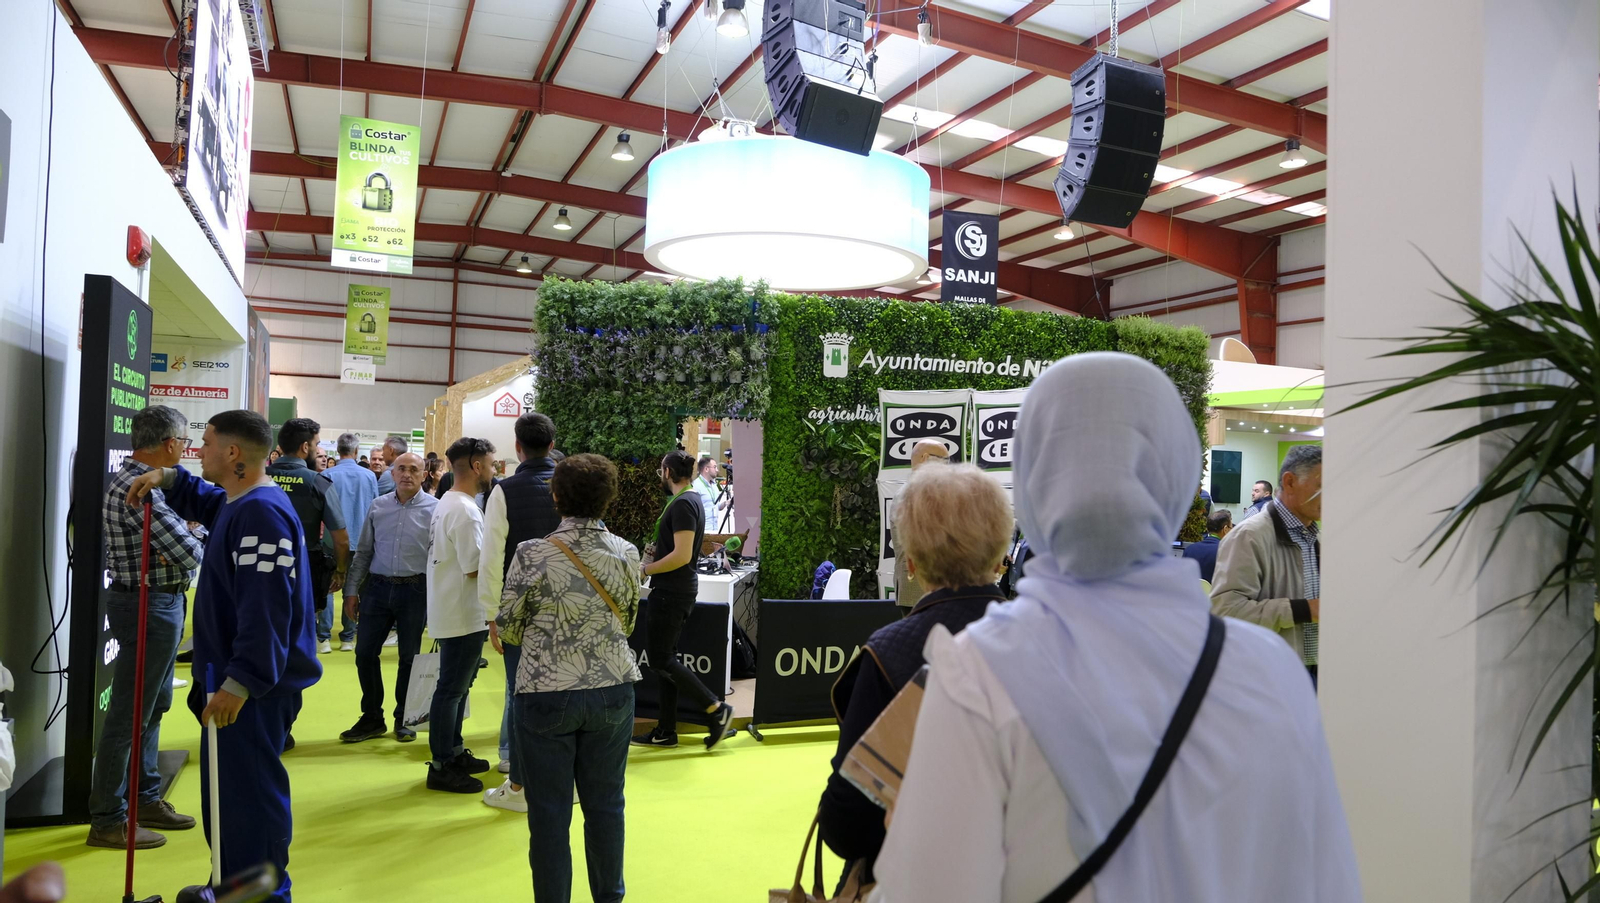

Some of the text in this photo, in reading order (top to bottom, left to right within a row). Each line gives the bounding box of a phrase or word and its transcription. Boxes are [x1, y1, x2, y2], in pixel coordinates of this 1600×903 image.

[365, 129, 407, 141] Costar
[350, 142, 396, 154] BLINDA
[349, 152, 410, 165] CULTIVOS
[944, 267, 995, 285] SANJI
[954, 295, 977, 303] MALLAS
[858, 348, 995, 375] Ayuntamiento
[996, 355, 1020, 376] de
[113, 362, 121, 382] EL
[166, 387, 181, 396] de
[182, 388, 227, 398] Almería
[807, 403, 882, 425] agricultur
[113, 415, 124, 434] DEL
[896, 419, 951, 431] ONDA
[986, 419, 1019, 432] OND
[989, 443, 1008, 458] CE
[272, 475, 304, 484] ARDIA
[281, 484, 293, 492] VIL
